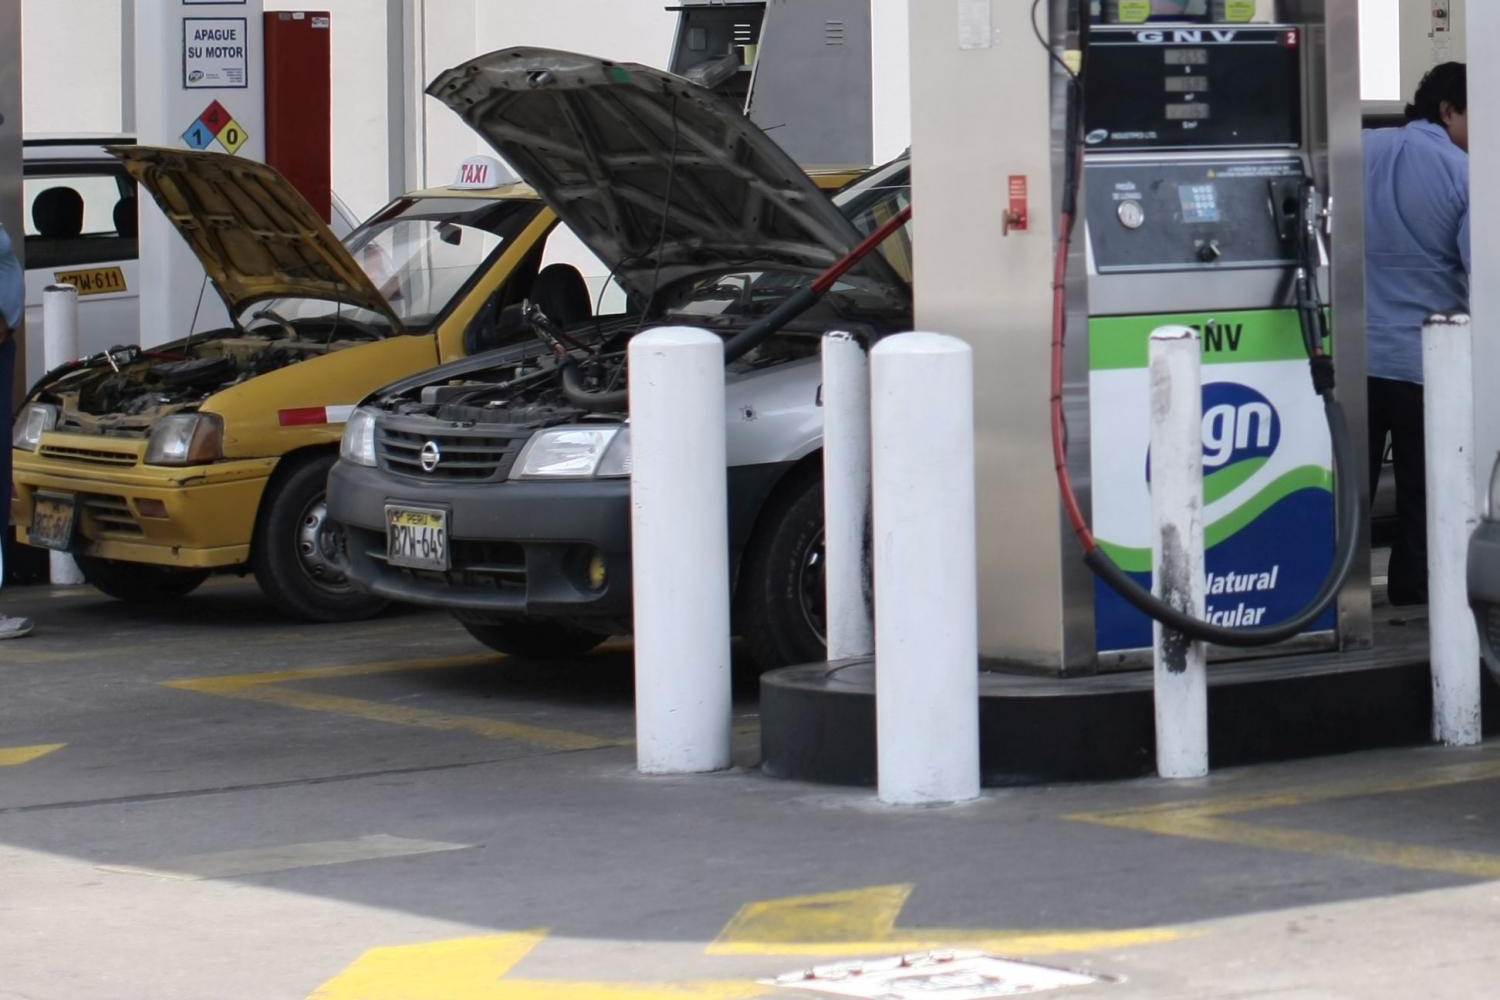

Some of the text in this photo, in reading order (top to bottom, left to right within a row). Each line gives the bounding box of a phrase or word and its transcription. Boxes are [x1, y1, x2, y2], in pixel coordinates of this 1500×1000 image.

[194, 29, 236, 40] APAGUE
[1287, 32, 1296, 44] 2
[188, 47, 243, 58] SU MOTOR
[208, 111, 219, 125] 4
[192, 128, 238, 145] 1 0
[461, 164, 488, 183] TAXI
